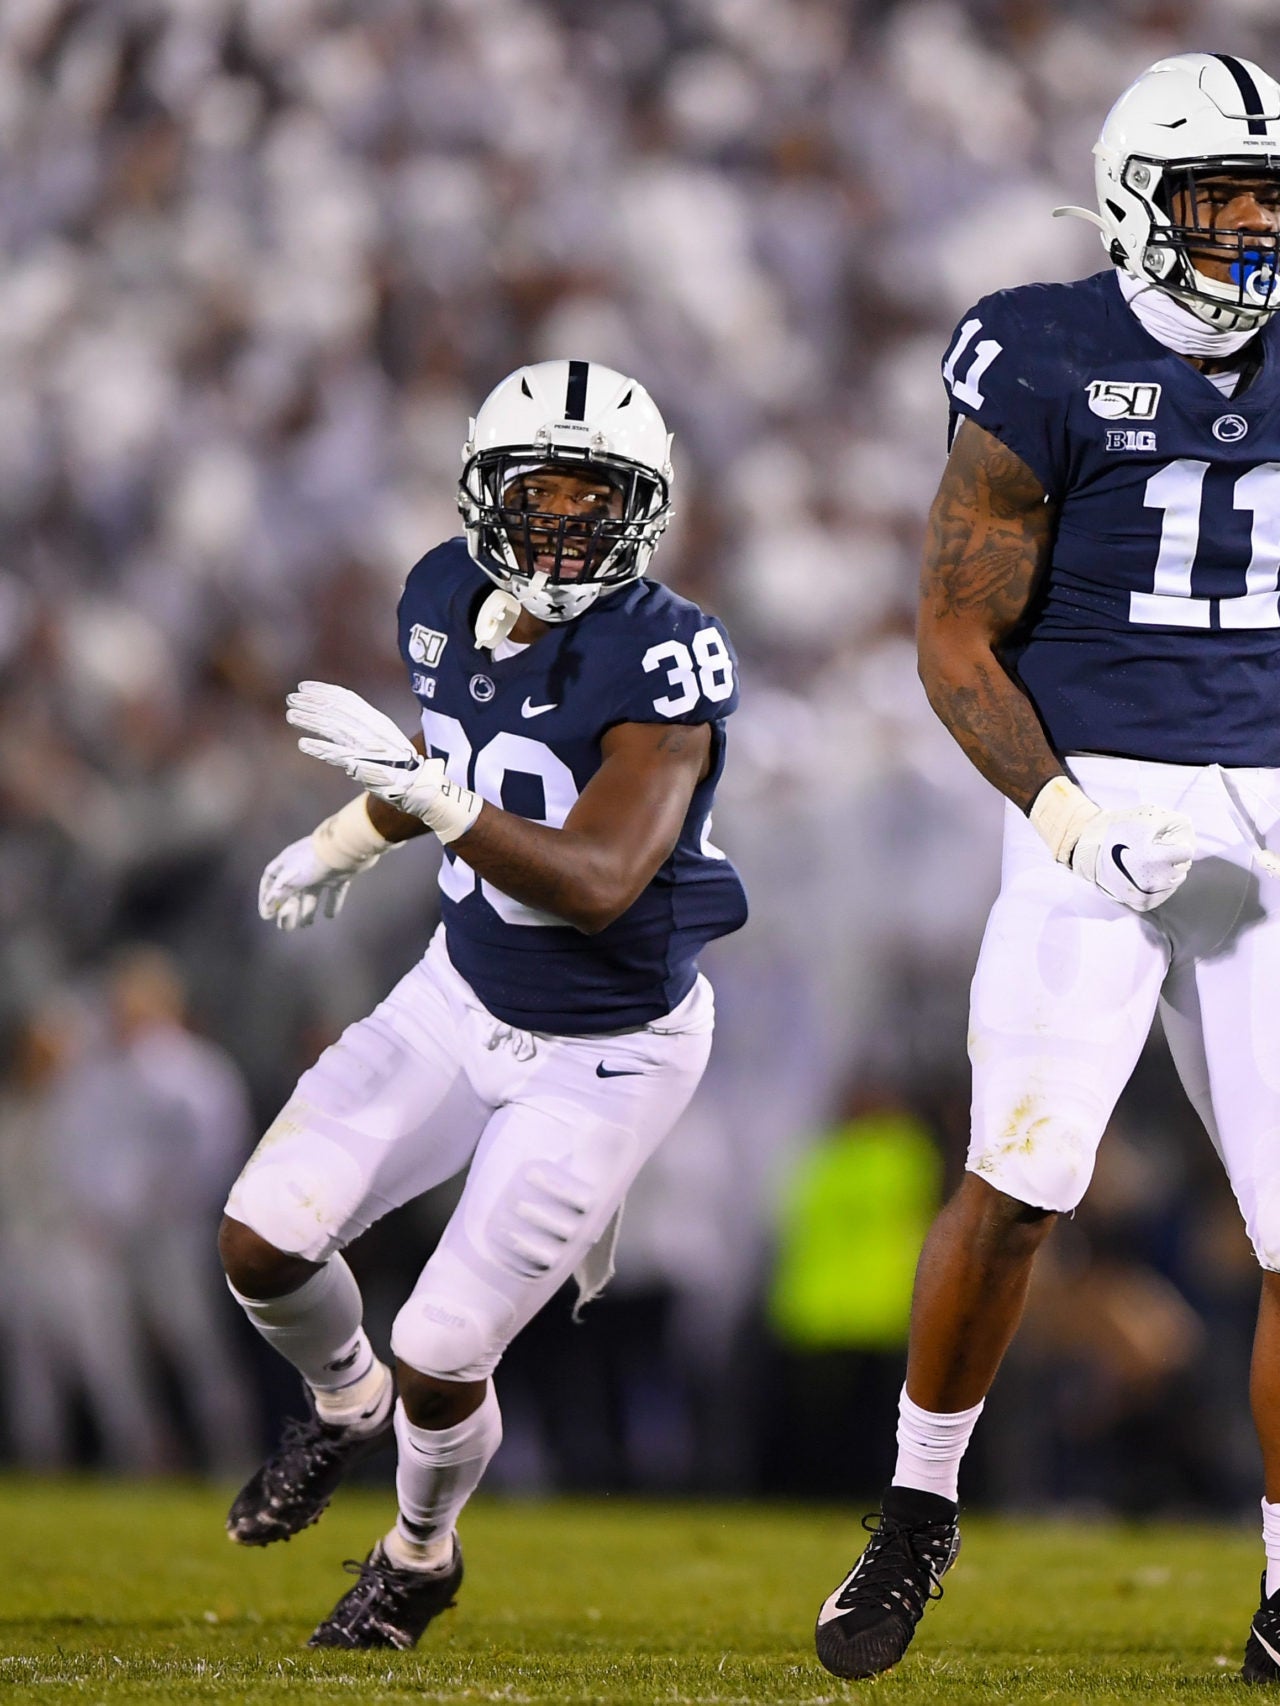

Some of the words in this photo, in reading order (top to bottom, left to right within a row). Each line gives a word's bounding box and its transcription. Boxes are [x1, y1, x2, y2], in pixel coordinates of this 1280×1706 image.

[943, 318, 1004, 410] 11
[1085, 380, 1161, 420] 150
[641, 626, 734, 718] 38
